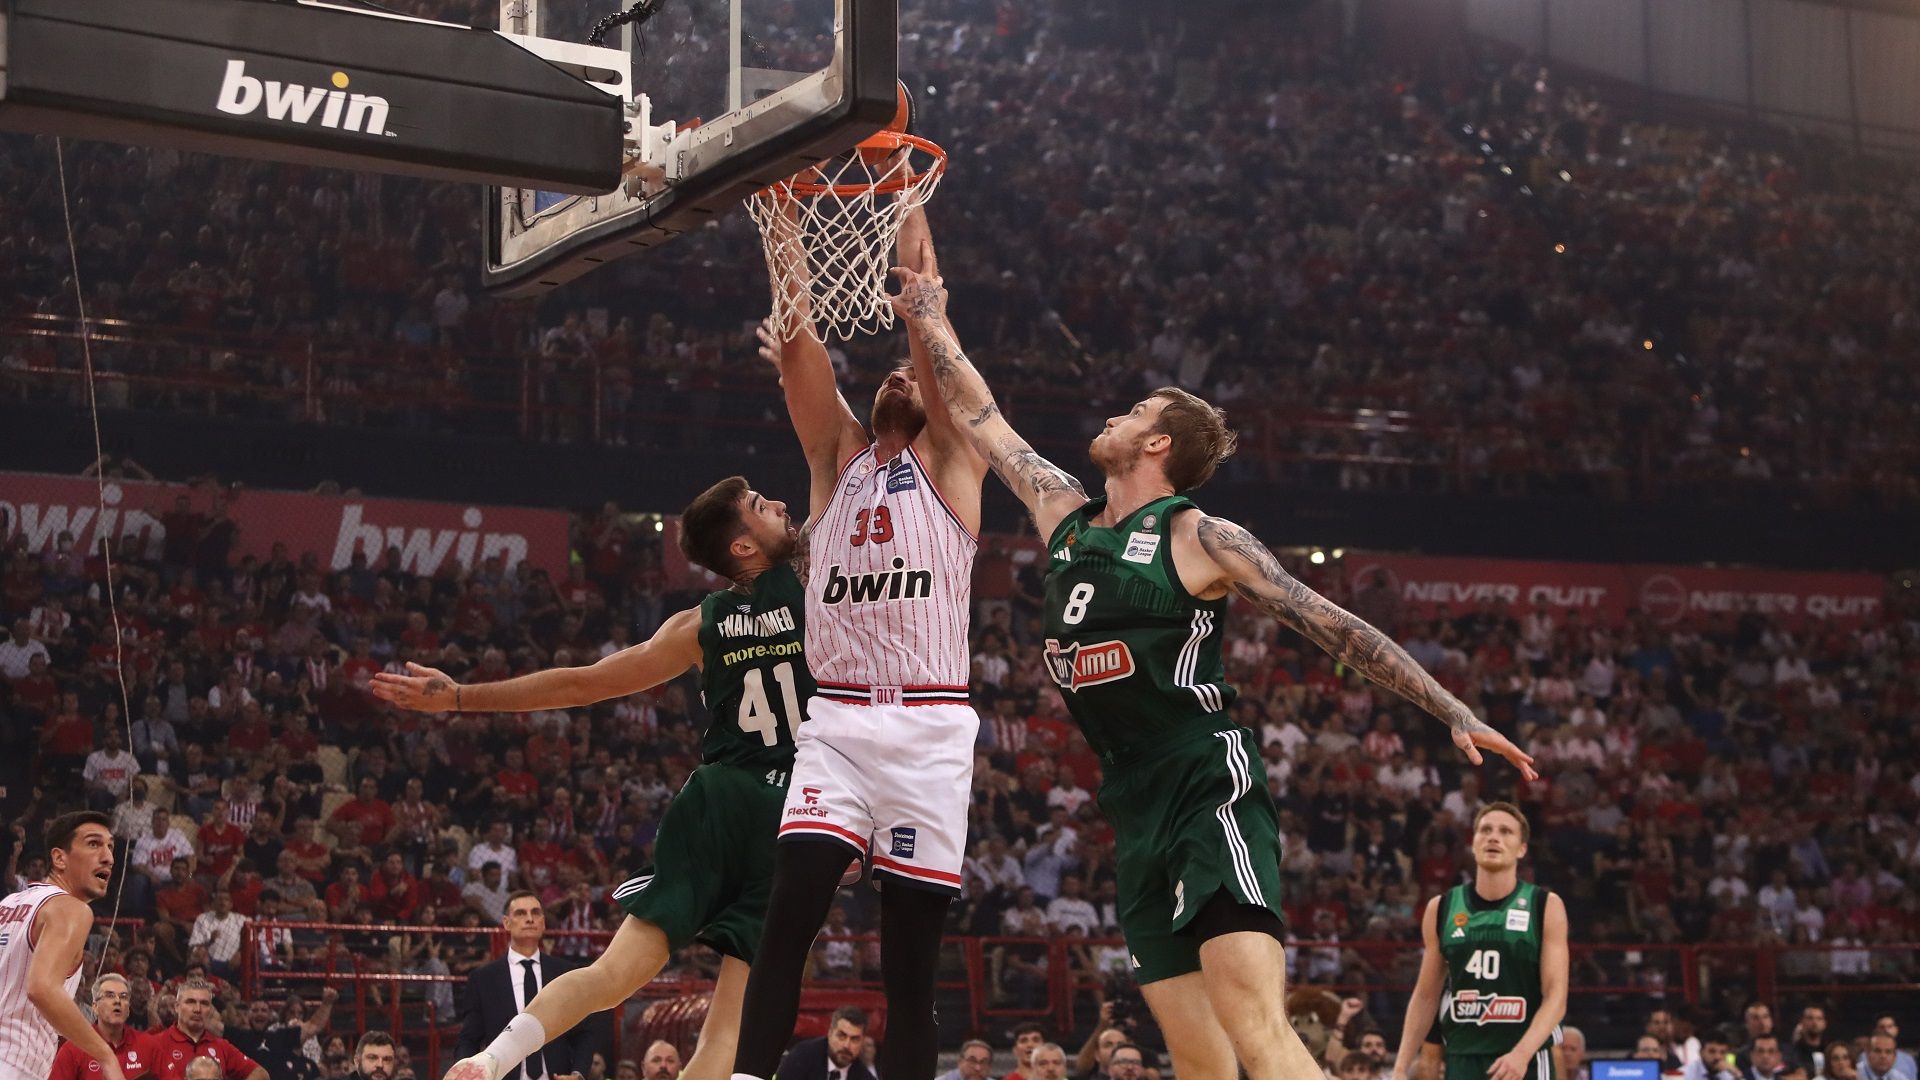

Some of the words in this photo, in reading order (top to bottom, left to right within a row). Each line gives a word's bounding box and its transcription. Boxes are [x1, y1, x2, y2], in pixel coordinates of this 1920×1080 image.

[216, 60, 389, 135] bwin
[0, 484, 166, 560] win
[850, 505, 895, 547] 33
[330, 504, 529, 578] bwin
[822, 557, 932, 604] bwin
[1404, 581, 1520, 604] NEVER
[1062, 582, 1095, 625] 8
[1806, 595, 1879, 618] QUIT
[723, 641, 802, 666] more.com
[738, 661, 803, 747] 41
[877, 689, 895, 703] OLY
[765, 769, 786, 787] 41
[787, 807, 828, 818] FlexCar
[1465, 950, 1500, 979] 40
